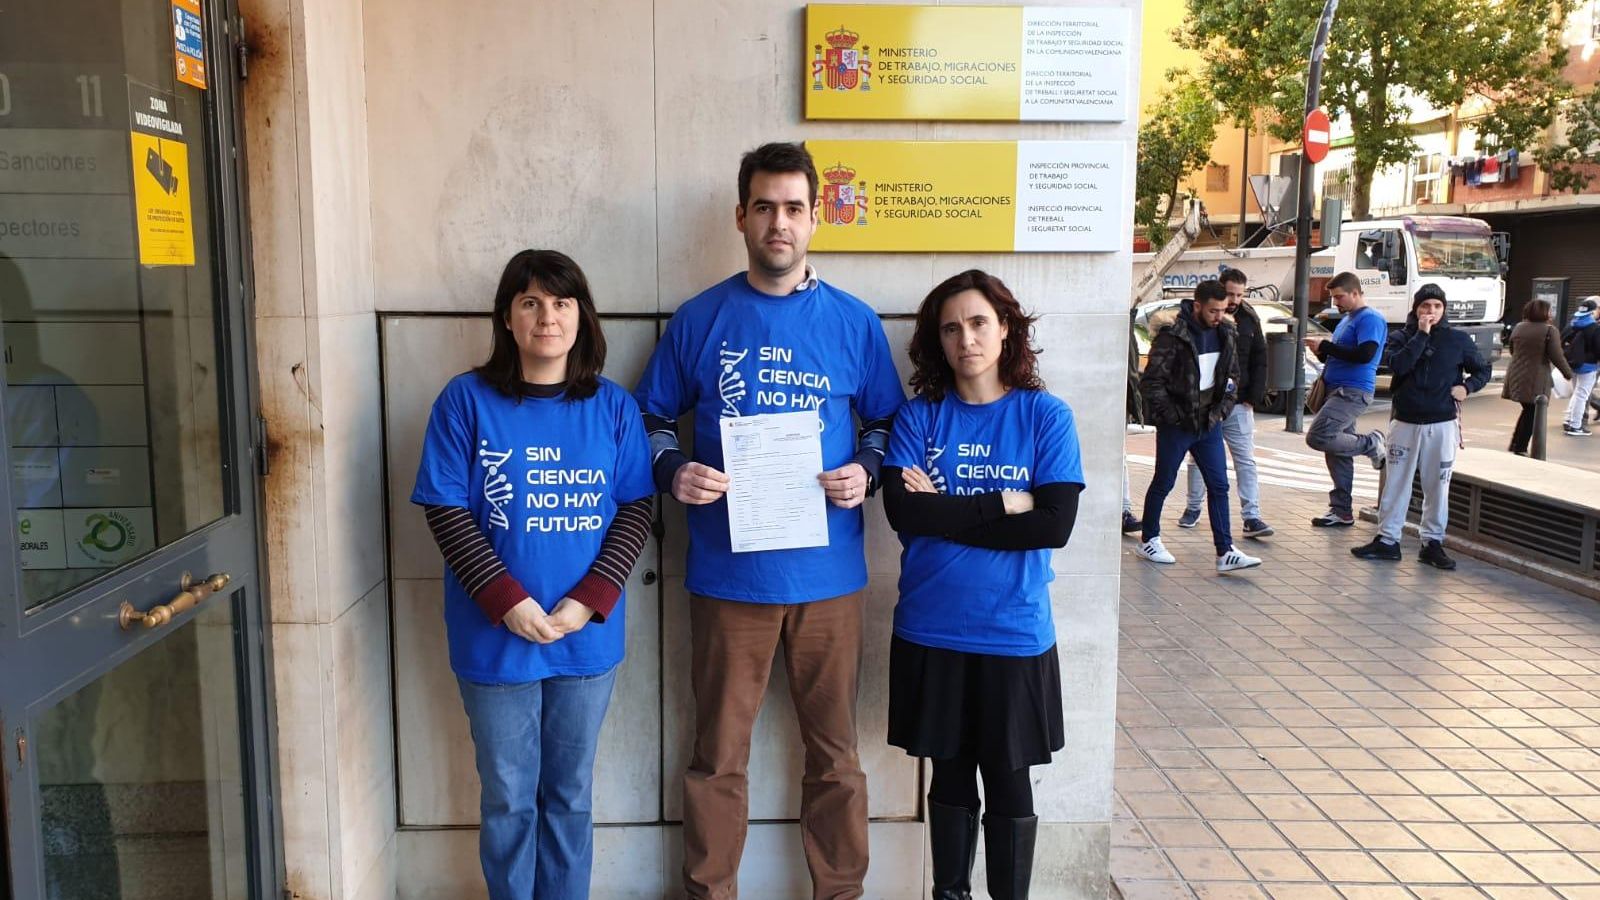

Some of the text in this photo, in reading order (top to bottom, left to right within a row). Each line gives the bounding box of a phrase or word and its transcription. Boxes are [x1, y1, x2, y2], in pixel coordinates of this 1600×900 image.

[878, 48, 938, 58] MINISTERIO
[878, 62, 1016, 73] DE TRABAJO, MIGRACIONES
[878, 75, 988, 85] Y SEGURIDAD SOCIAL
[76, 75, 104, 117] 11
[150, 96, 168, 113] ZONA
[135, 111, 183, 135] VIDEOVIGILADA
[0, 152, 96, 171] Sanciones
[875, 183, 933, 192] MINISTERIO
[875, 196, 1011, 207] DE TRABAJO, MIGRACIONES
[875, 209, 982, 218] Y SEGURIDAD SOCIAL
[760, 347, 792, 363] SIN
[758, 369, 831, 391] CIENCIA
[757, 391, 825, 413] NO HAY
[526, 447, 560, 461] SIN
[958, 444, 991, 457] SIN
[526, 469, 606, 485] CIENCIA
[956, 464, 1030, 481] CIENCIA
[527, 493, 603, 508] NO HAY
[526, 516, 602, 532] FUTURO
